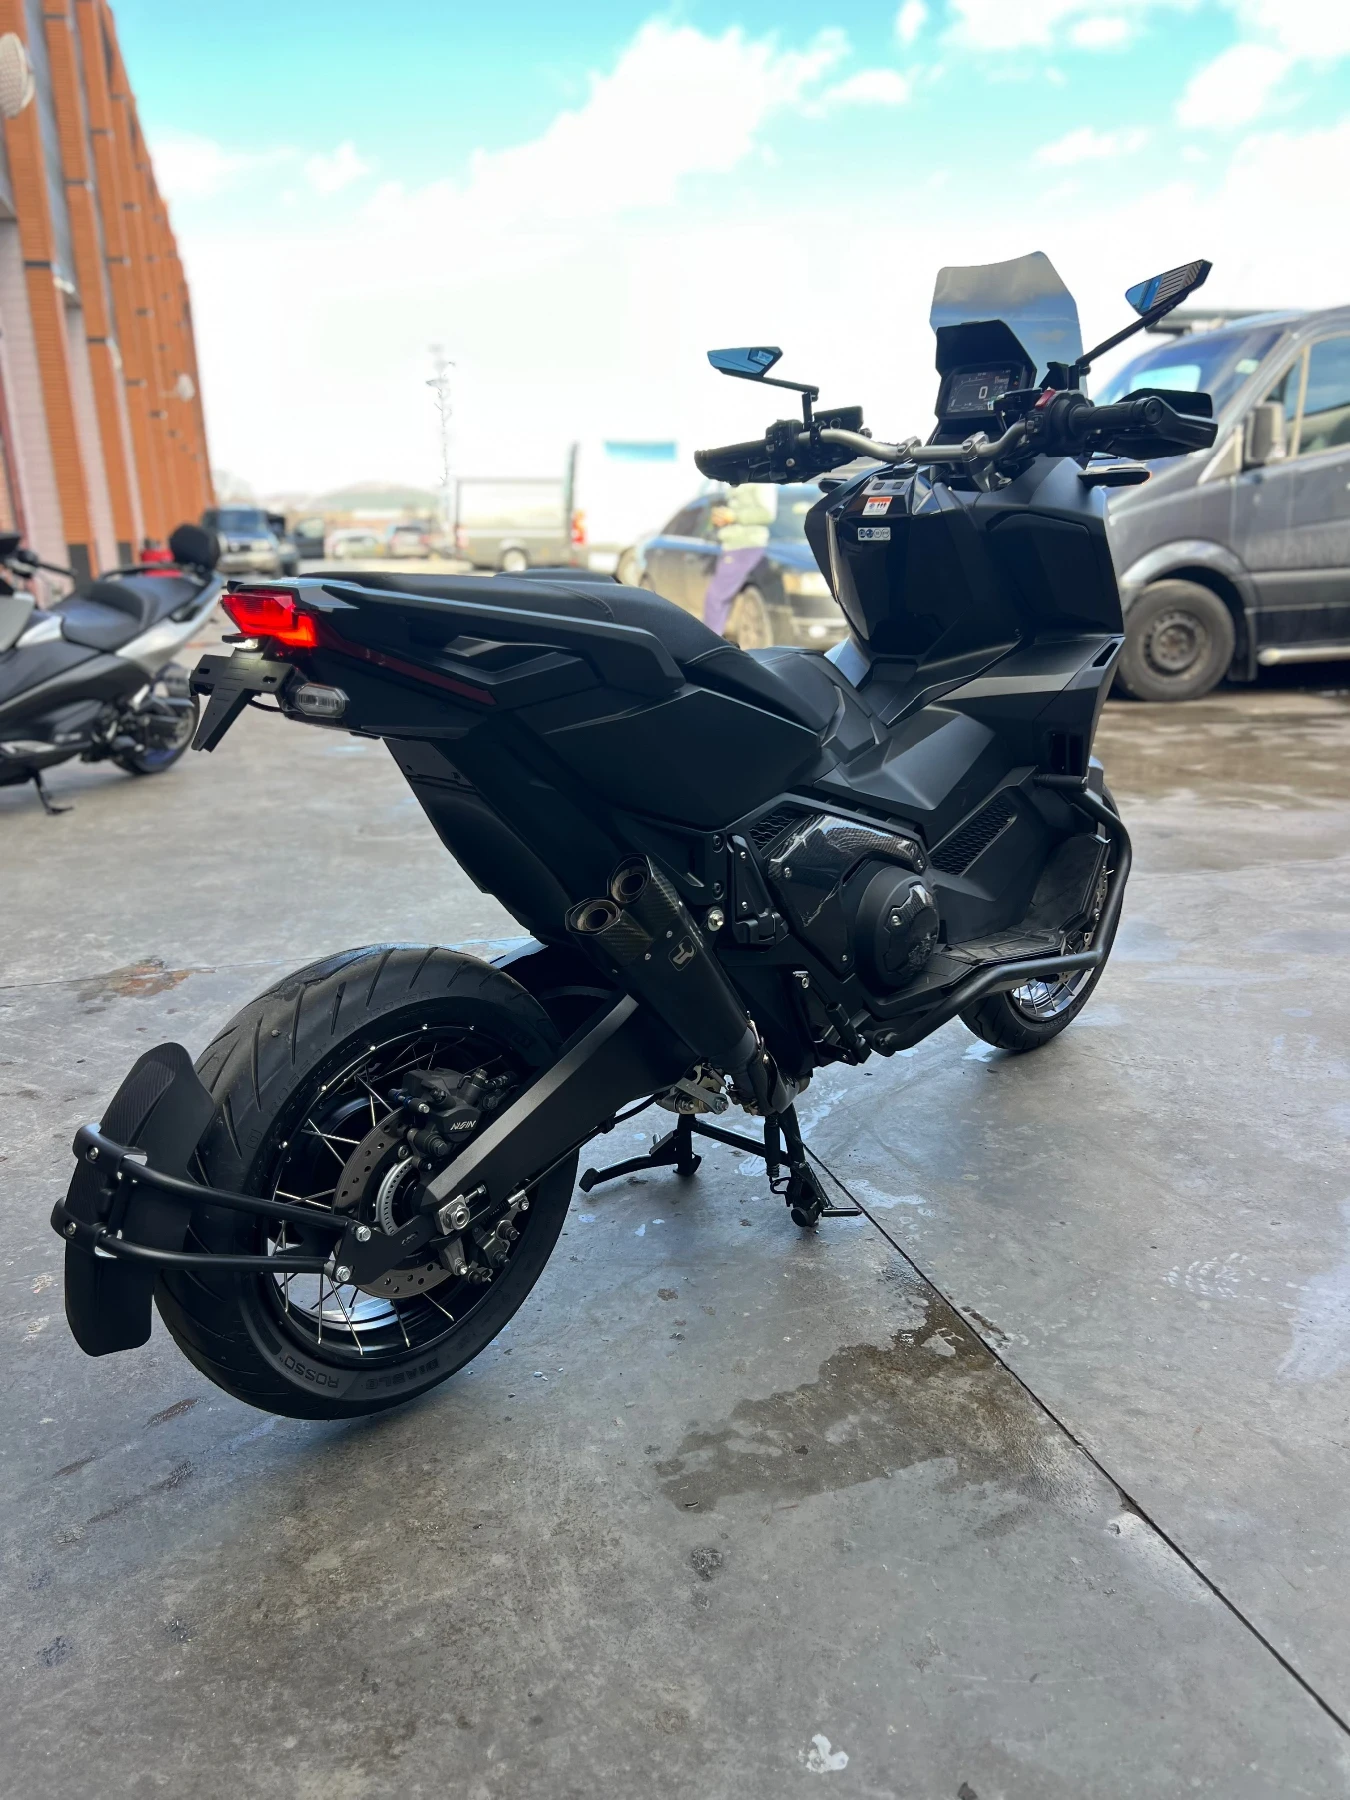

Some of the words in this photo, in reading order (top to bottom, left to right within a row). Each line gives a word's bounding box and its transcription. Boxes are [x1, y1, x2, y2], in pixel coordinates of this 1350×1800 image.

[979, 386, 988, 399] 0
[283, 1355, 339, 1388] ROSSO
[365, 1358, 440, 1389] DIABLO
